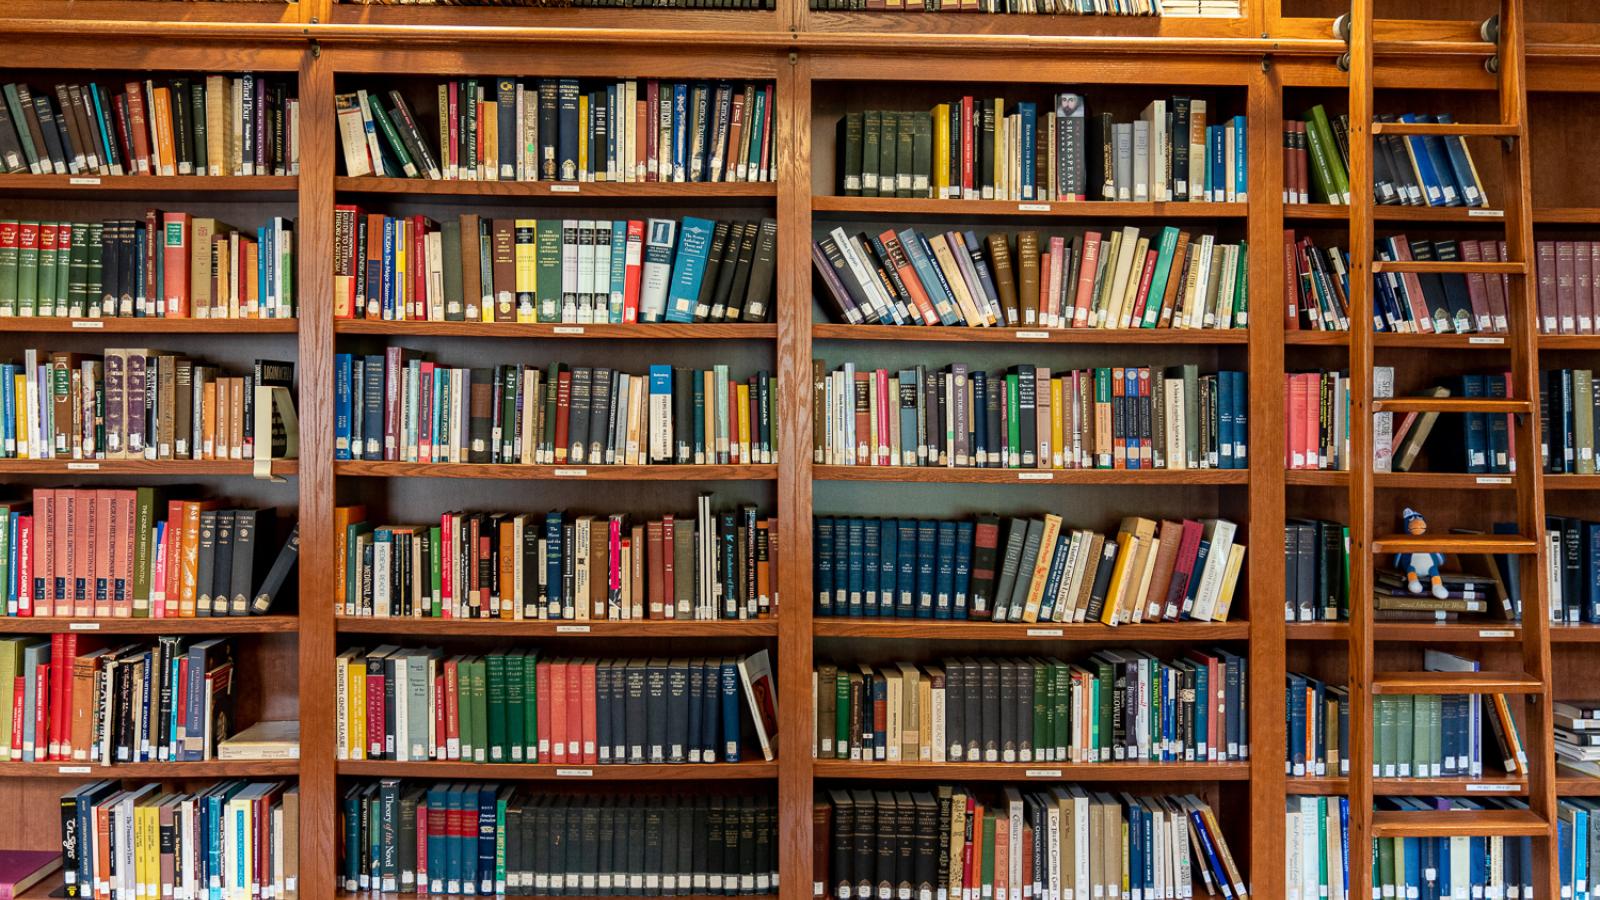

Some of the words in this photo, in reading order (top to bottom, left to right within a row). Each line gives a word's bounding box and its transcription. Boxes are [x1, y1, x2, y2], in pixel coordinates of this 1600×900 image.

[243, 75, 252, 100] Grand
[243, 101, 252, 120] Tour
[1382, 381, 1390, 435] SHAPEARE
[1064, 564, 1074, 586] English
[384, 794, 394, 822] Theory
[67, 819, 76, 834] On
[63, 834, 76, 859] Signs
[386, 832, 394, 844] the
[386, 846, 394, 867] Novel
